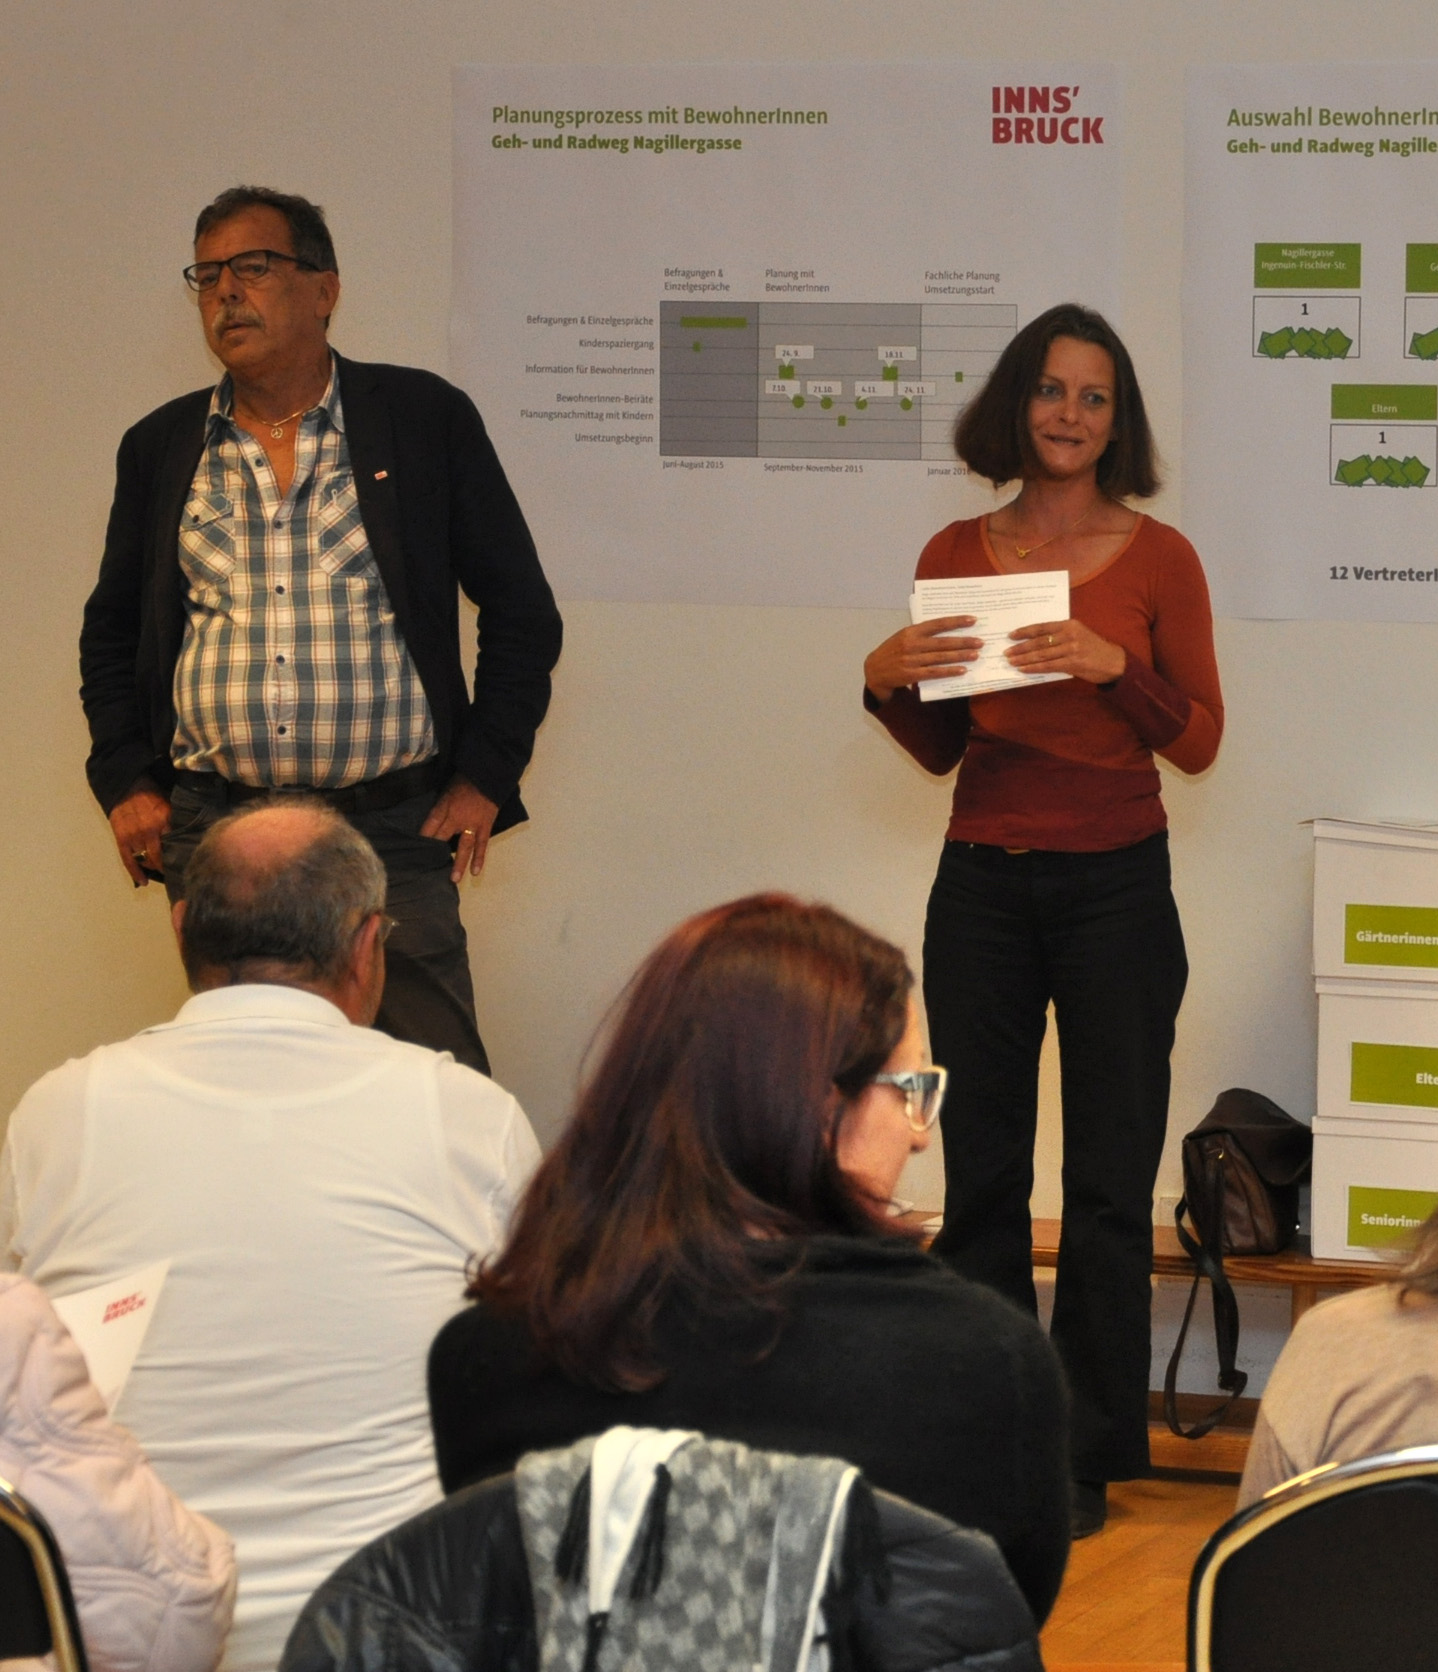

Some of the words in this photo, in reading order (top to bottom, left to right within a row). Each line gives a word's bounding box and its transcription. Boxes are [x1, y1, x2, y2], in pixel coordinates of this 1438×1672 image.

[492, 106, 643, 128] Planungsprozess
[648, 106, 679, 124] mit
[684, 105, 829, 124] BewohnerInnen
[1227, 106, 1312, 126] Auswahl
[992, 116, 1104, 144] BRUCK
[492, 133, 528, 149] Geh-
[532, 134, 563, 149] und
[567, 135, 629, 153] Radweg
[633, 135, 742, 153] Nagillergasse
[1227, 138, 1266, 154] Geh-
[1270, 138, 1303, 153] und
[1307, 138, 1374, 158] Radweg
[1281, 248, 1335, 260] Nagillergasse
[664, 268, 716, 279] Befragungen
[717, 268, 724, 278] &
[765, 269, 798, 280] Planung
[800, 269, 815, 279] mit
[924, 271, 964, 280] Fachliche
[966, 271, 1000, 282] Planung
[664, 282, 730, 293] Einzelgespräche
[765, 283, 830, 292] BewohnerInnen
[924, 286, 995, 296] Umsetzungsstart
[1301, 303, 1309, 315] 1
[526, 315, 578, 326] Befragungen
[580, 316, 586, 325] &
[588, 315, 654, 327] Einzelgespräche
[579, 339, 654, 350] Kinderspaziergang
[525, 364, 574, 374] Information
[576, 364, 588, 374] für
[590, 365, 655, 375] BewohnerInnen
[1371, 403, 1398, 413] Eltern
[520, 409, 604, 421] Planungsnachmittag
[606, 411, 620, 420] mit
[622, 410, 654, 420] Kindern
[575, 434, 653, 444] Umsetzungsbeginn
[1379, 431, 1387, 444] 1
[663, 461, 705, 470] Juni-August
[706, 461, 724, 470] 2015
[764, 463, 843, 473] September-November
[845, 465, 863, 473] 2015
[927, 467, 951, 476] Januar
[1329, 566, 1348, 581] 12
[1361, 1212, 1425, 1228] Seniorinn
